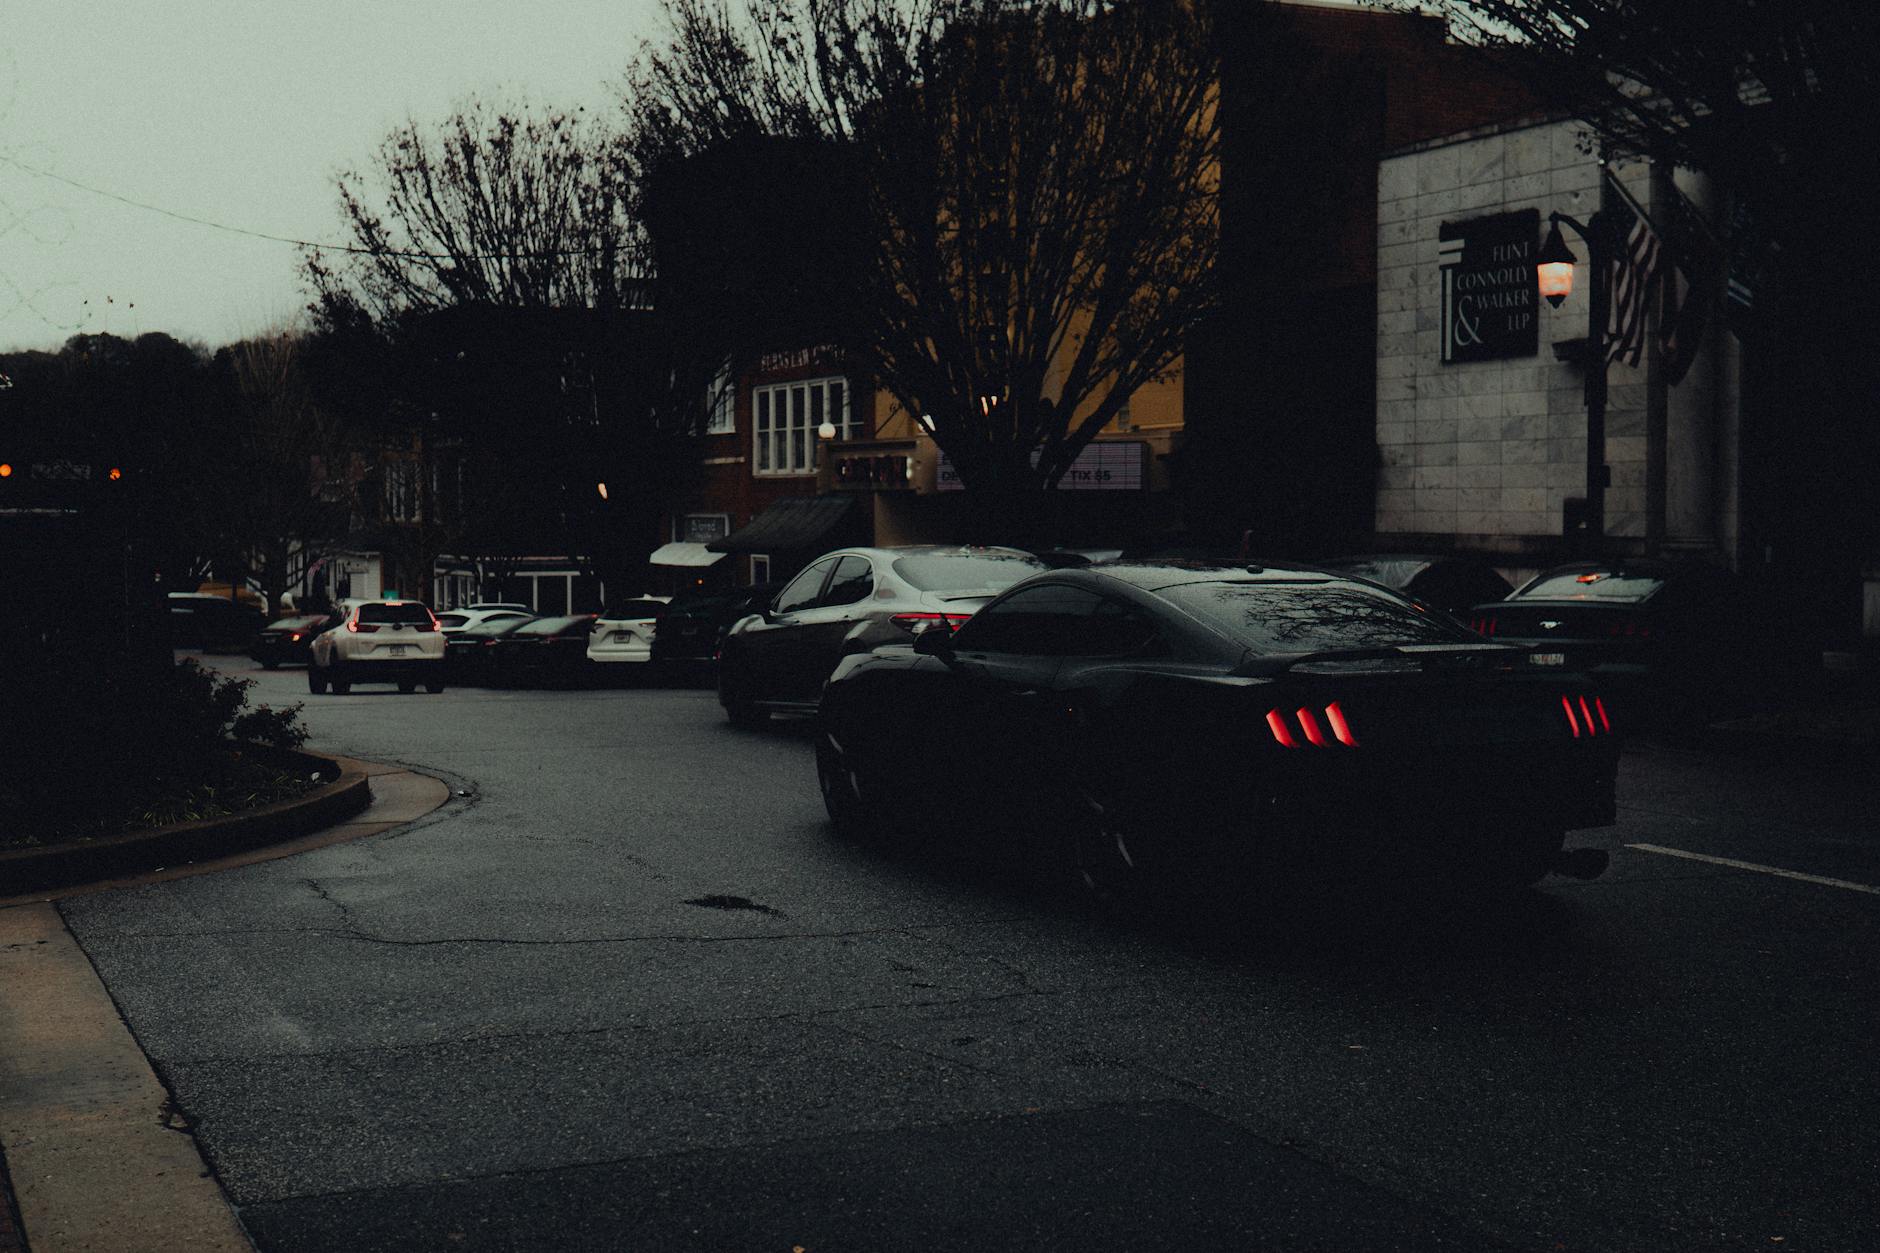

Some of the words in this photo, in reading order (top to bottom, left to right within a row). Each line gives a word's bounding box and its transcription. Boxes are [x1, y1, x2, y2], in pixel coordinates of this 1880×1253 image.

[1493, 241, 1529, 262] FLINT
[1456, 266, 1529, 290] CONNOLLY
[1455, 295, 1484, 346] &
[1477, 288, 1529, 309] WALKER
[1508, 312, 1530, 330] LLP
[1070, 470, 1092, 481] TIX
